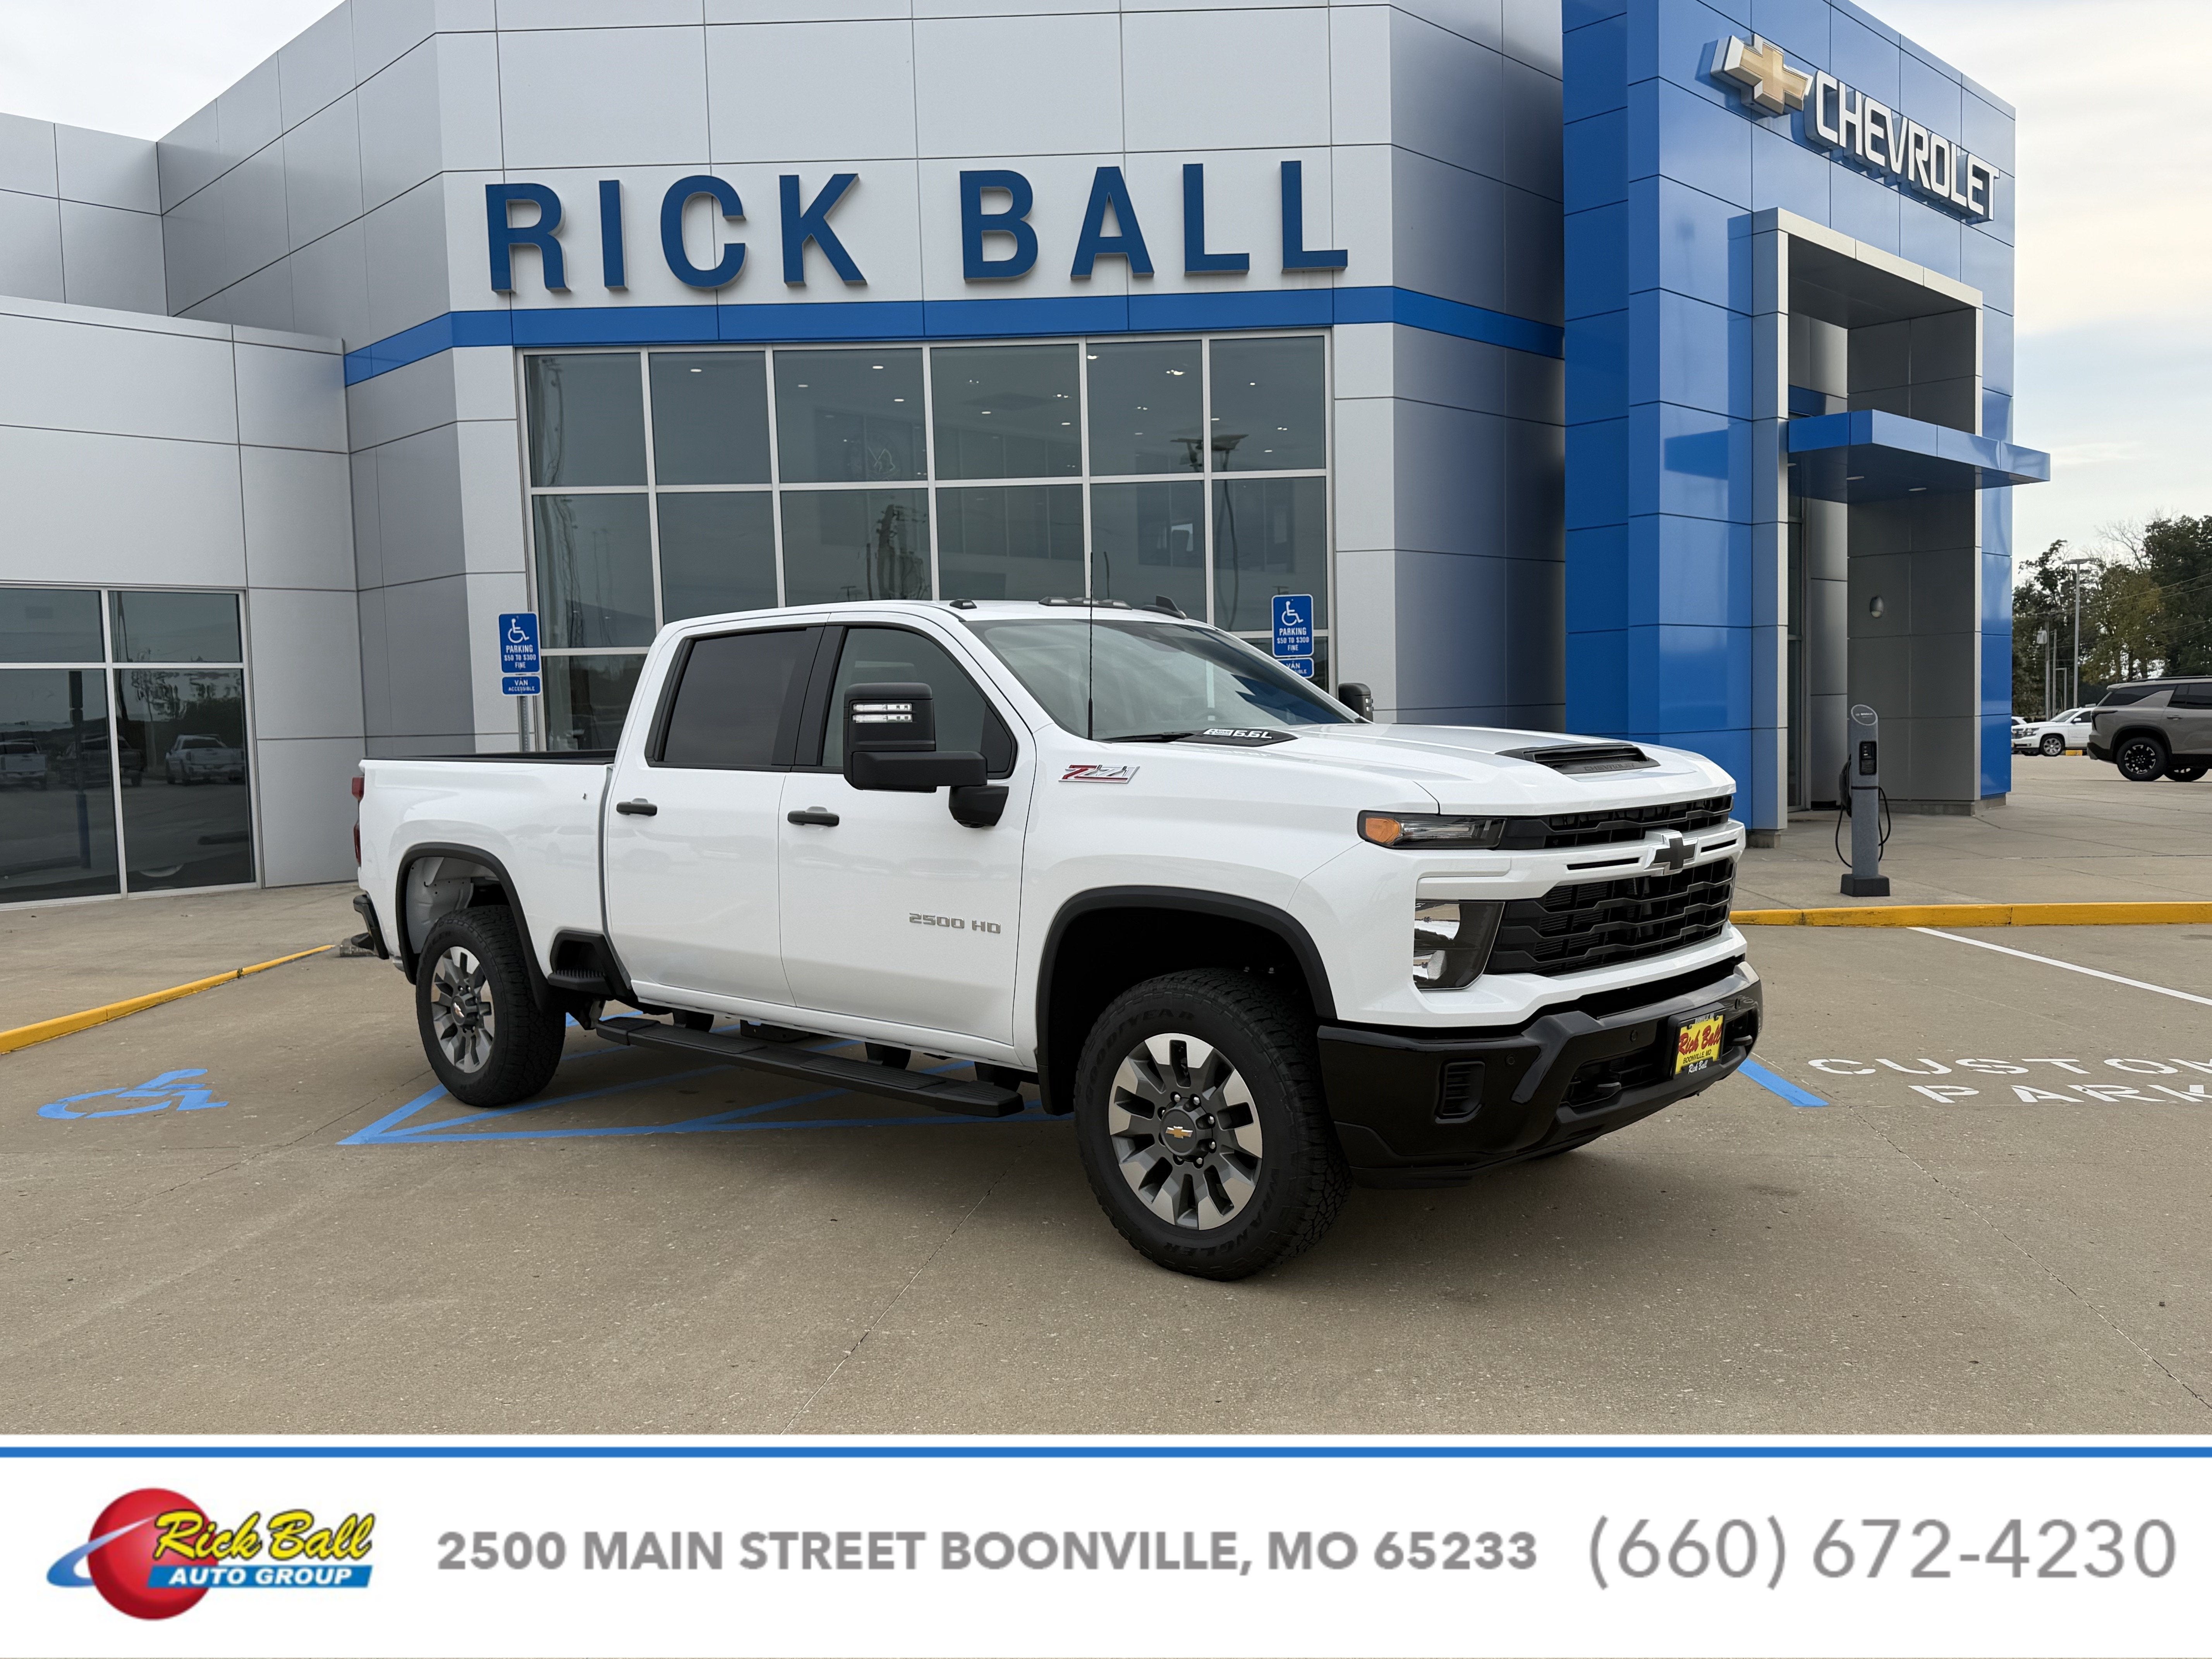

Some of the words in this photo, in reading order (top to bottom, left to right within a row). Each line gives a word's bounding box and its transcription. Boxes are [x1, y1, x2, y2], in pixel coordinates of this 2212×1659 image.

[1815, 70, 2000, 221] CHEVROLET
[485, 173, 867, 294] RICK
[960, 160, 1348, 283] BALL
[1279, 627, 1307, 636] PARKING
[506, 644, 533, 653] PARKING
[1233, 730, 1272, 739] 6.6L
[1058, 764, 1140, 784] Z71
[1584, 763, 1635, 772] CHEVROLET
[909, 912, 965, 929] 2500
[972, 920, 1001, 934] HD
[1678, 1029, 1700, 1056] Rick
[1701, 1024, 1722, 1049] Ball
